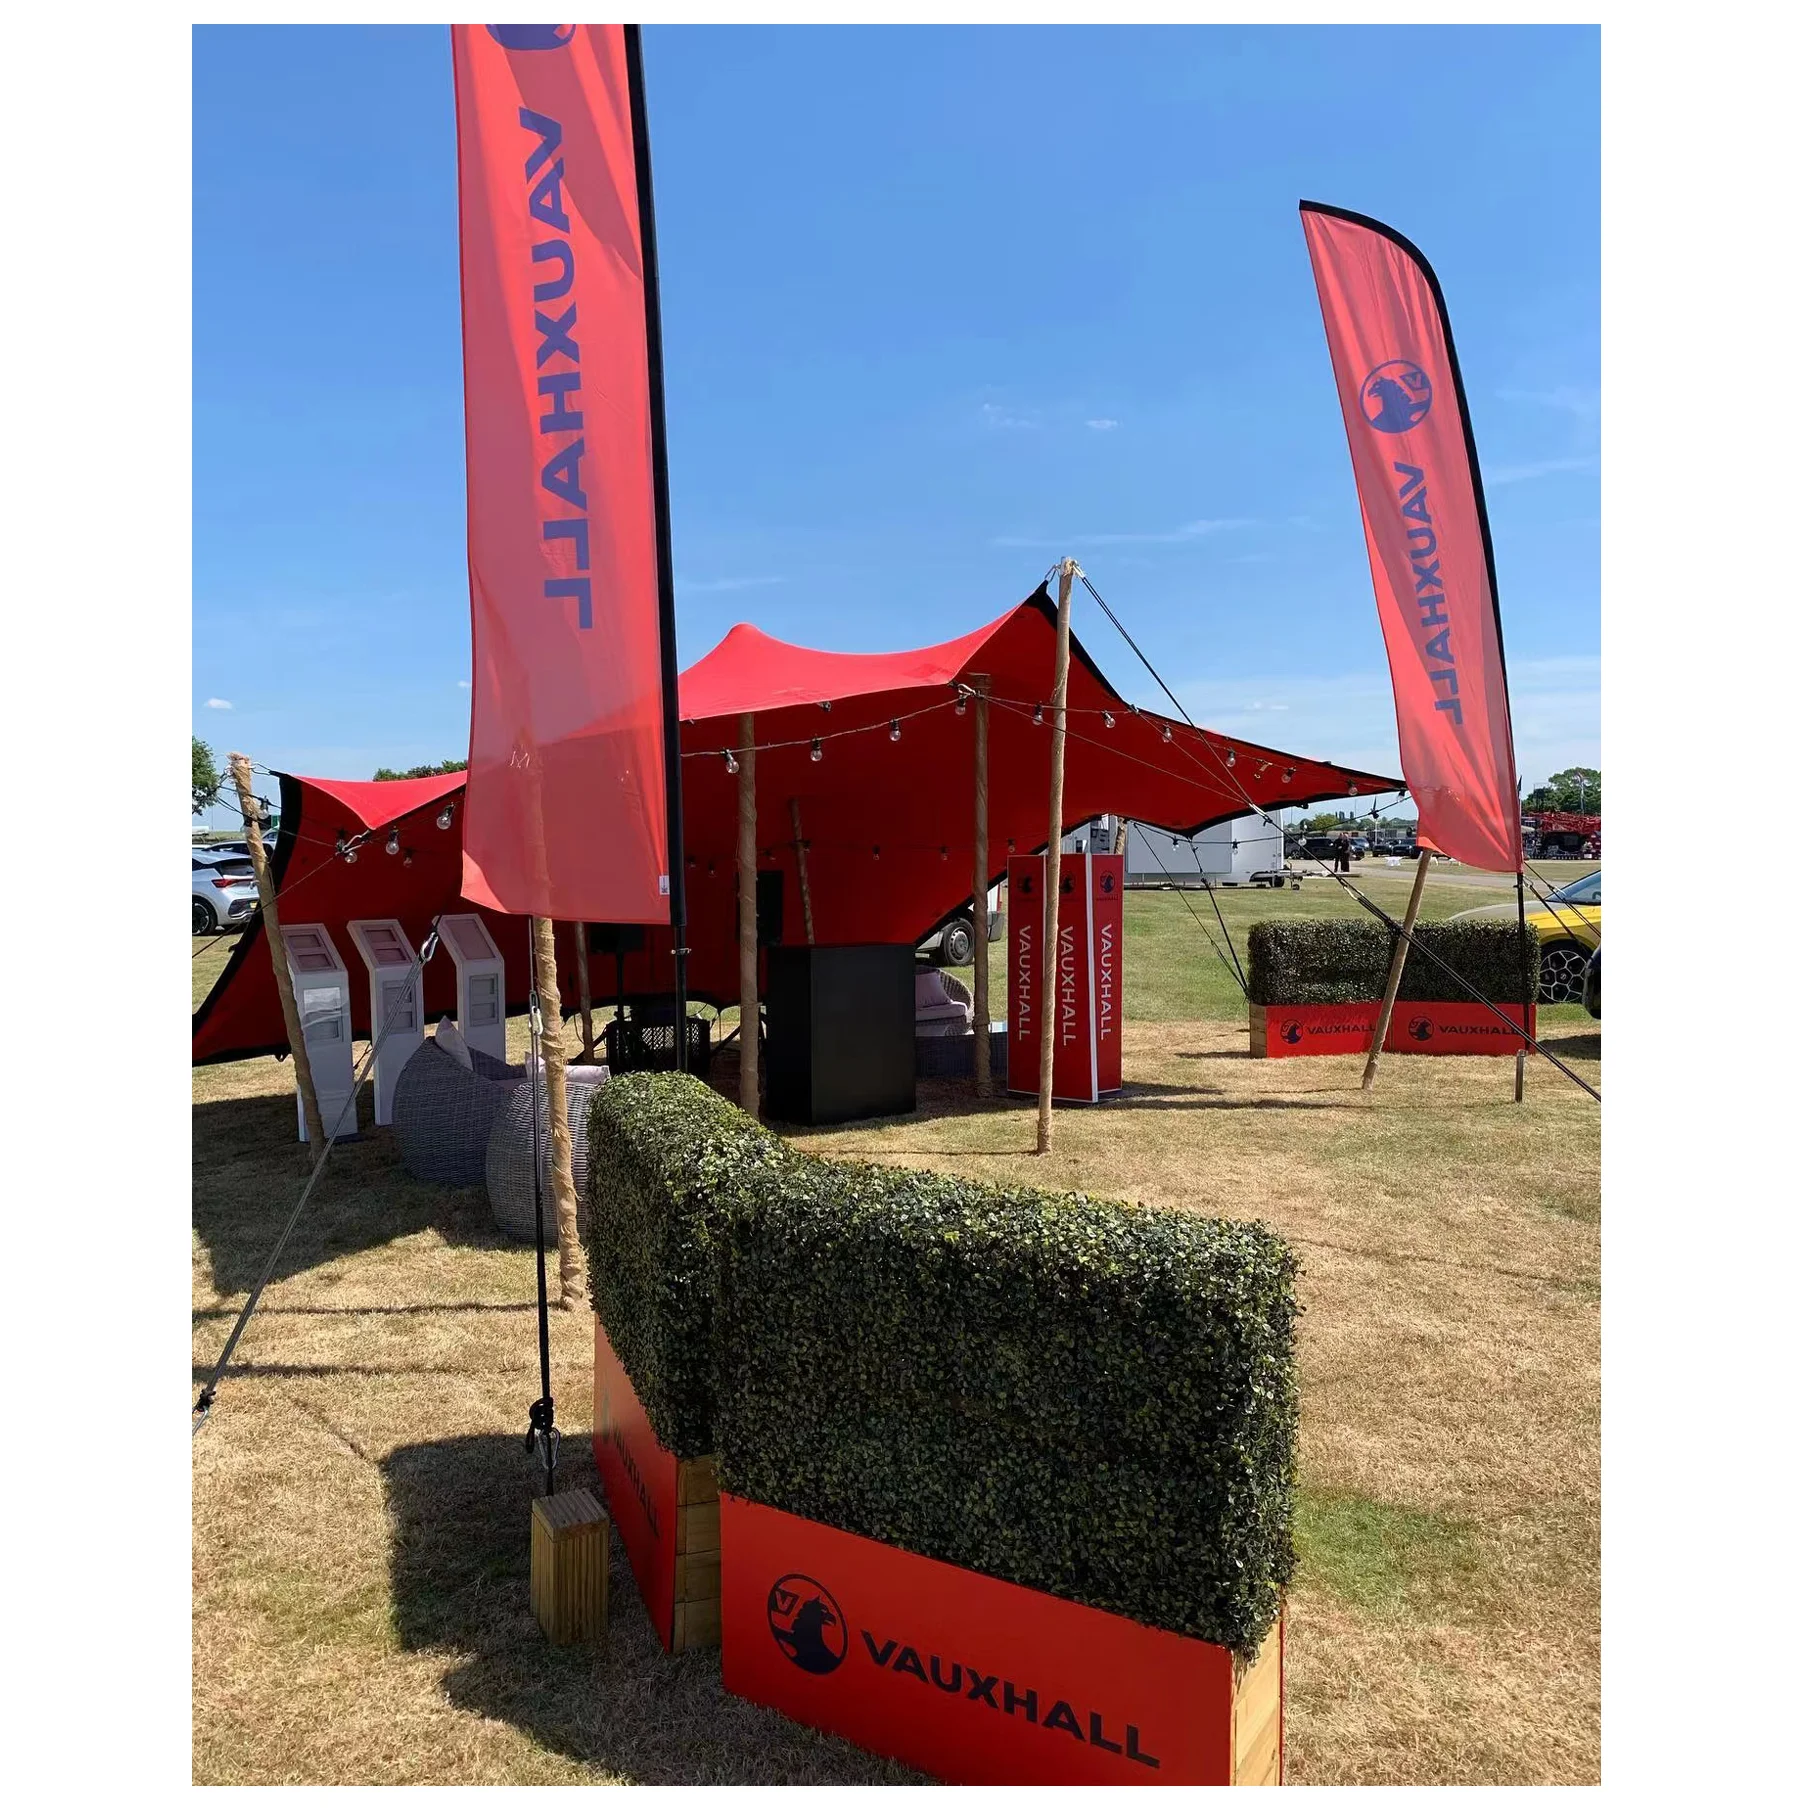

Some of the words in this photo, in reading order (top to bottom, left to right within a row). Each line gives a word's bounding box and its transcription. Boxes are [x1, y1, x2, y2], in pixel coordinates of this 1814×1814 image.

[1019, 925, 1031, 1041] VAUXHALL
[1060, 925, 1077, 1046] VAUXHALL
[1101, 923, 1113, 1041] VAUXHALL
[1307, 1023, 1376, 1035] VAUXHALL
[860, 1629, 1161, 1769] VAUXHALL
